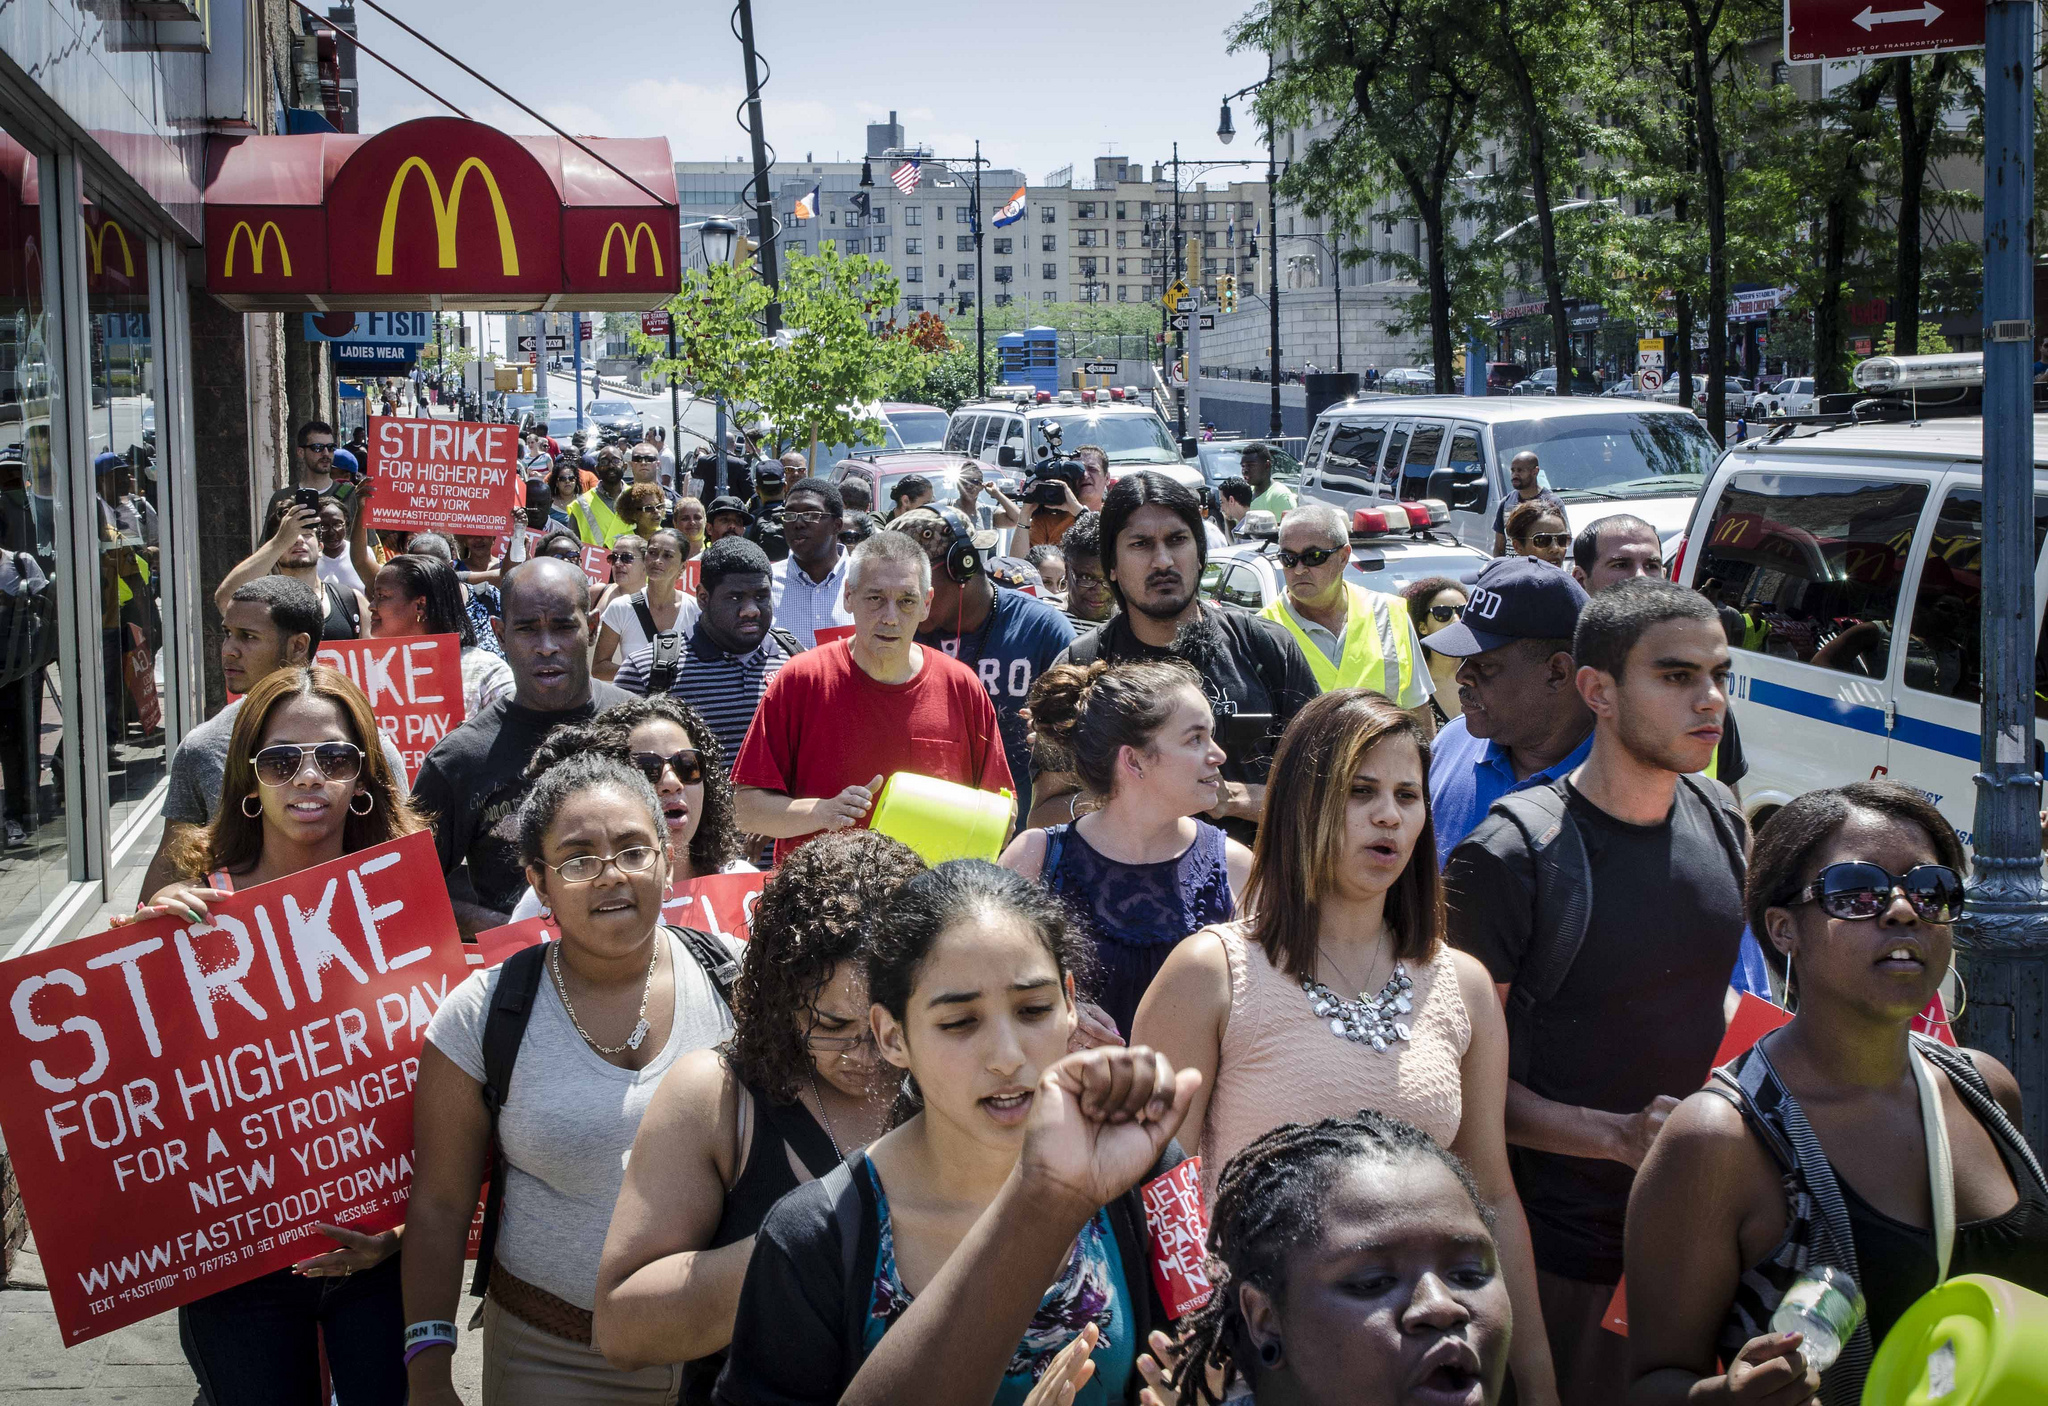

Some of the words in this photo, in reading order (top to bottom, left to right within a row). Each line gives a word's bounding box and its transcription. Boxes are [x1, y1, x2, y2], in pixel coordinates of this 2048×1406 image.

[1884, 38, 1954, 49] TRANSPORTATION
[340, 345, 374, 358] LADIES
[377, 347, 405, 359] WEAR
[380, 422, 507, 463] STRIKE
[379, 460, 413, 479] FOR
[417, 463, 478, 484] HIGHER
[480, 468, 509, 486] PAY
[392, 481, 416, 493] FOR
[418, 484, 427, 495] A
[430, 484, 490, 499] STRONGER
[372, 507, 507, 525] WWW.FASTFOODFORWARD.ORG
[410, 496, 439, 508] NEW
[441, 498, 471, 511] YORK
[10, 852, 432, 1092] STRIKE
[45, 1078, 163, 1162] FOR
[175, 1008, 371, 1121] HIGHER
[376, 974, 447, 1051] PAY
[114, 1139, 188, 1191] FOR
[208, 1128, 230, 1164] A
[241, 1058, 420, 1149] STRONGER
[189, 1154, 275, 1213] NEW
[290, 1117, 385, 1177] YORK
[78, 1148, 416, 1296] WWW.FASTFOODFORWA
[89, 1295, 116, 1315] TEXT
[120, 1273, 180, 1303] "FASTFOOD"
[184, 1266, 198, 1281] TO
[241, 1245, 255, 1259] TO
[257, 1237, 275, 1253] GET
[333, 1200, 380, 1226] MESSAGE
[392, 1184, 413, 1204] DAT
